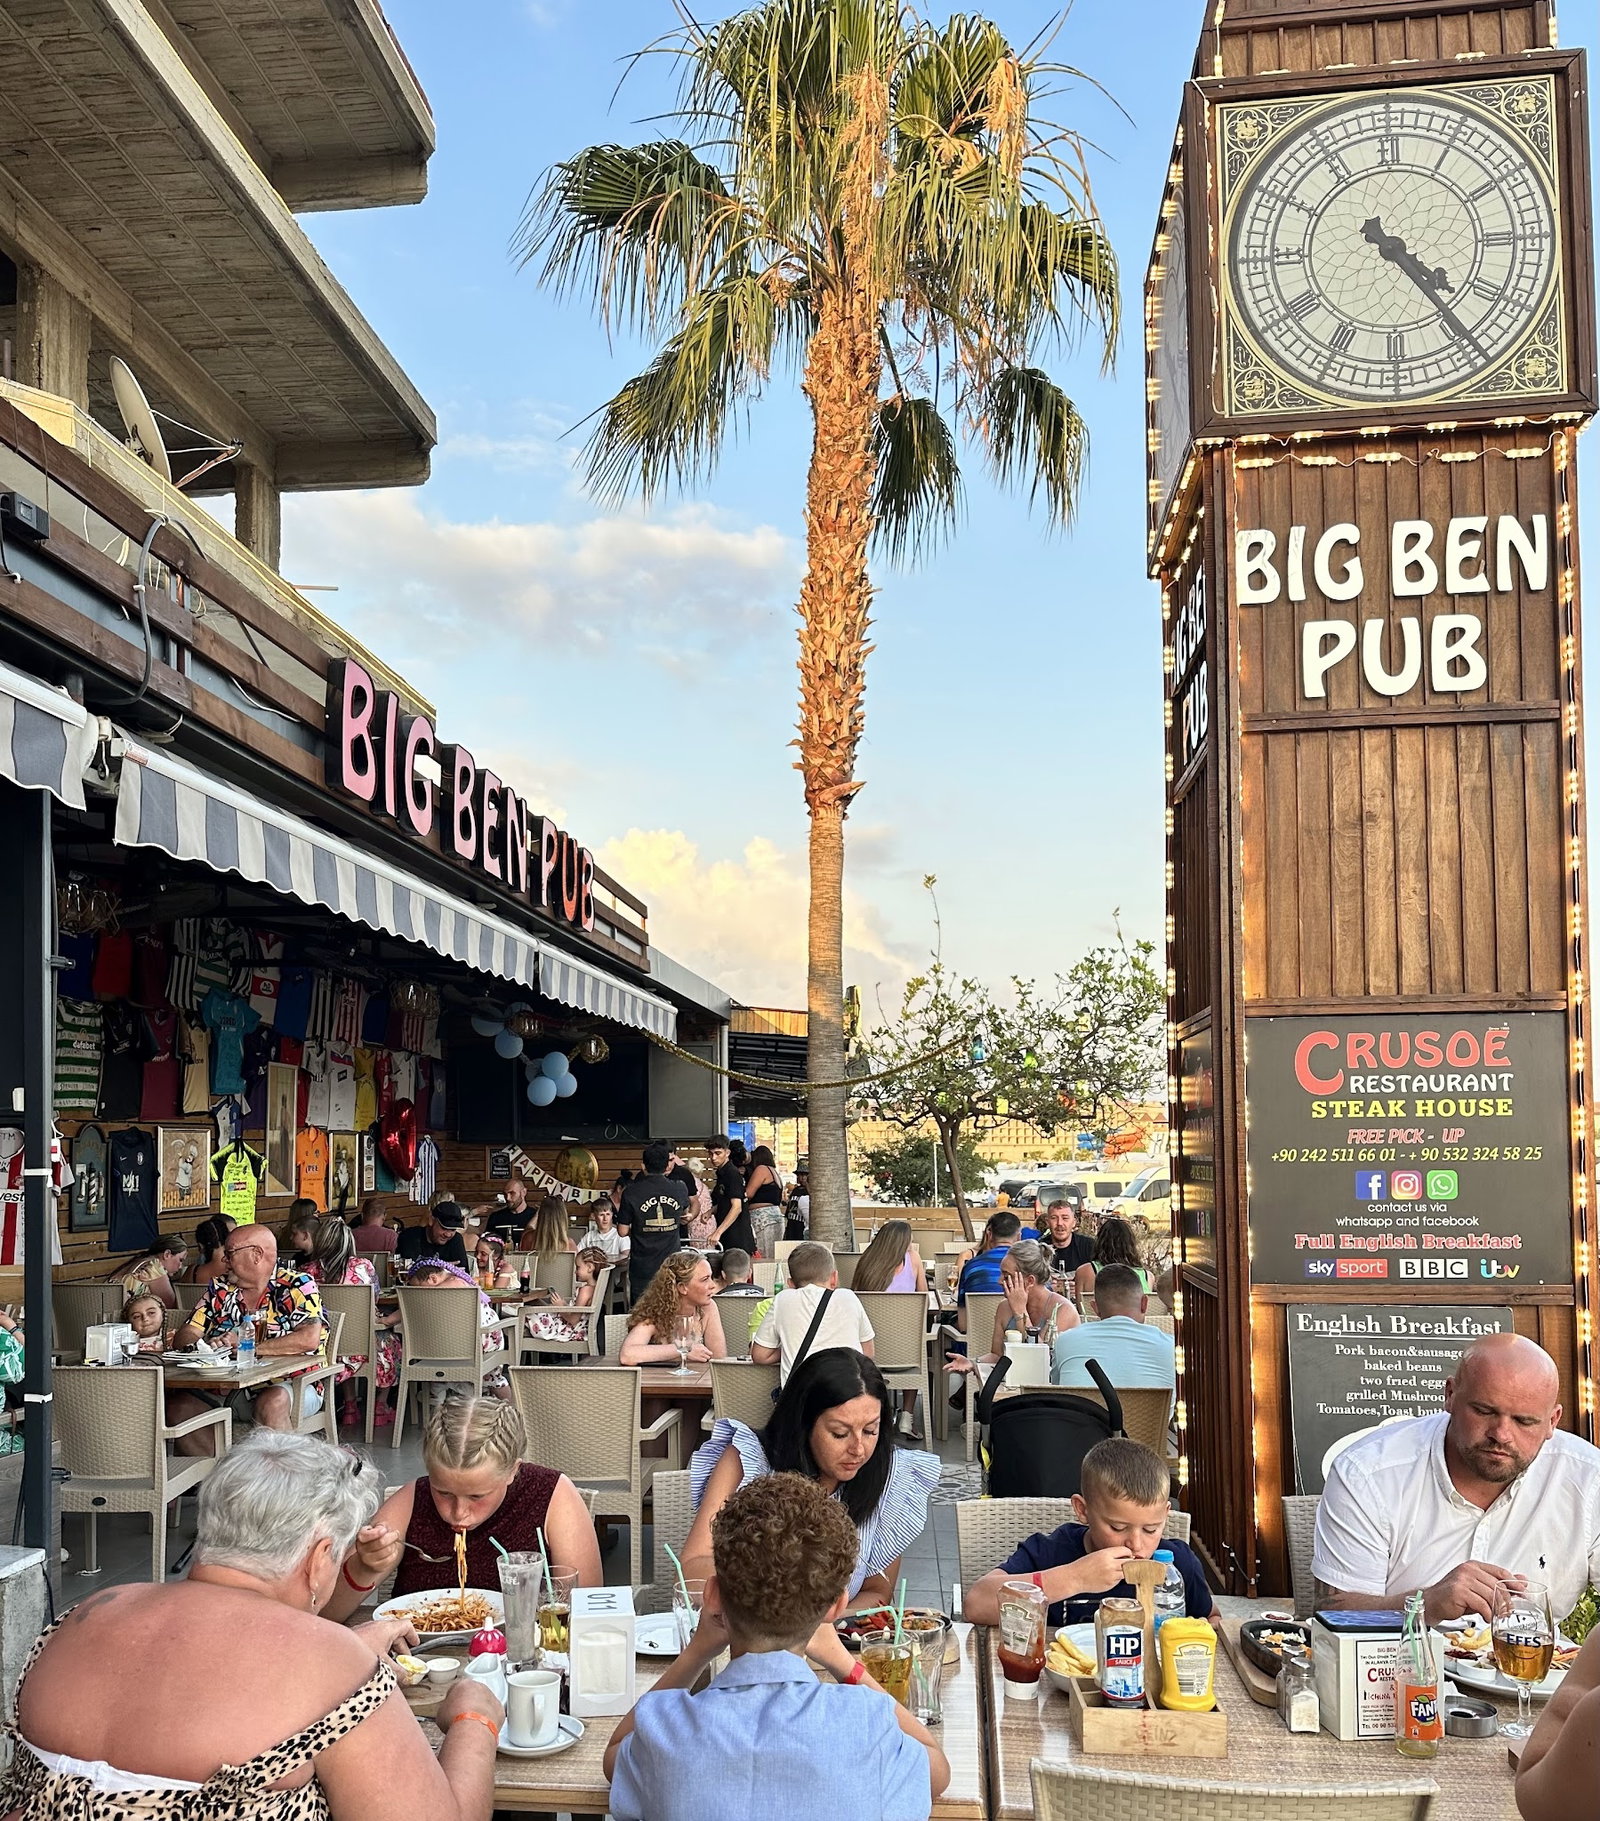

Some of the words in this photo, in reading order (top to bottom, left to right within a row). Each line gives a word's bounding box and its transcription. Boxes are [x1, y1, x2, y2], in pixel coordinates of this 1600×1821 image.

[1236, 523, 1364, 605] BIG
[1391, 514, 1548, 596] BEN
[1302, 613, 1488, 699] PUB
[1183, 660, 1208, 767] PUB
[342, 656, 435, 837] BIG
[453, 743, 527, 893] BEN
[541, 815, 594, 934] PUB
[1294, 1030, 1512, 1096] CRUSOE
[1350, 1073, 1514, 1094] RESTAURANT
[1311, 1100, 1407, 1119] STEAK
[1415, 1098, 1513, 1117] HOUSE
[1347, 1128, 1385, 1145] FREE
[1388, 1128, 1424, 1144] PICK
[1442, 1127, 1465, 1144] UP
[1271, 1149, 1297, 1162] +90
[1300, 1149, 1327, 1162] 242
[1330, 1148, 1354, 1162] 511
[1358, 1148, 1376, 1162] 66
[1379, 1148, 1396, 1161] 01
[1421, 1148, 1439, 1161] 90
[1442, 1148, 1468, 1161] 532
[1472, 1148, 1498, 1161] 324
[1503, 1147, 1520, 1160] 58
[1524, 1146, 1543, 1160] 25
[508, 1144, 568, 1193] HAPPY
[640, 1197, 658, 1213] BIG
[660, 1195, 680, 1211] BEN
[1367, 1202, 1413, 1213] contact
[1415, 1204, 1428, 1213] us
[1429, 1202, 1447, 1213] via
[1335, 1216, 1393, 1229] whatsapp
[1396, 1216, 1420, 1227] and
[1421, 1215, 1480, 1227] facebook
[1294, 1233, 1335, 1249] Full
[1339, 1233, 1418, 1251] English
[1421, 1233, 1522, 1250] Breakfast
[1308, 1259, 1335, 1276] sky
[1338, 1261, 1384, 1276] sport
[1402, 1260, 1467, 1277] BBC
[1480, 1258, 1520, 1279] itv
[1297, 1313, 1381, 1336] English
[1389, 1315, 1502, 1335] Breakfast
[1334, 1344, 1366, 1356] Pork
[1364, 1360, 1402, 1371] baked
[1406, 1361, 1443, 1373] beans
[1360, 1376, 1383, 1386] two
[1386, 1375, 1417, 1387] fried
[1420, 1379, 1447, 1390] eggs
[1346, 1389, 1387, 1402] grilled
[1390, 1390, 1446, 1402] Mushroo
[1110, 1636, 1139, 1656] HP
[1507, 1633, 1541, 1648] EFES
